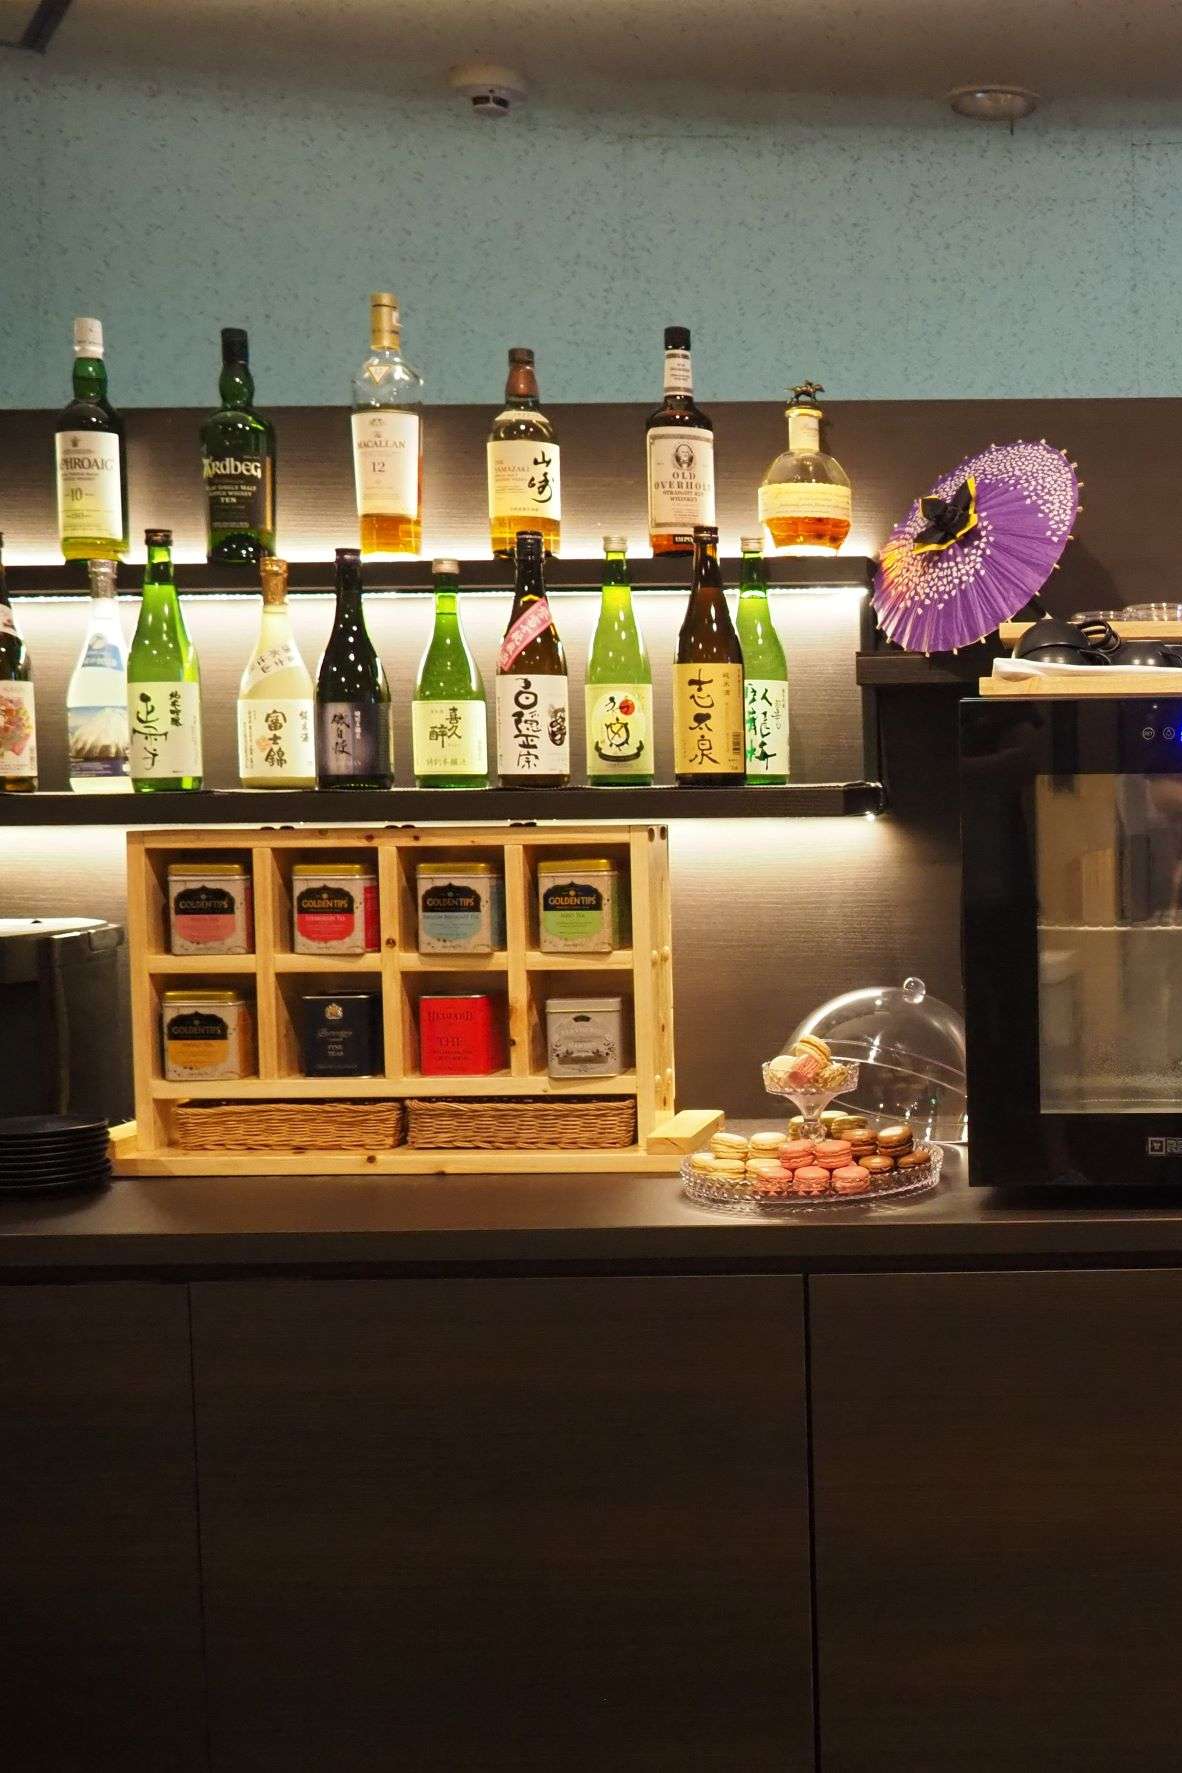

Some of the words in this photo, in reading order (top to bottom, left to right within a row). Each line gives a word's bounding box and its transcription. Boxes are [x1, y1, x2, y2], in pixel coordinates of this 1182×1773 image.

[357, 440, 406, 449] MACALLAN
[370, 461, 386, 473] 12
[527, 450, 555, 504] 山崎
[672, 471, 696, 480] OLD
[69, 487, 83, 502] 10
[688, 668, 721, 765] 志太泉
[264, 709, 287, 768] 富士錦
